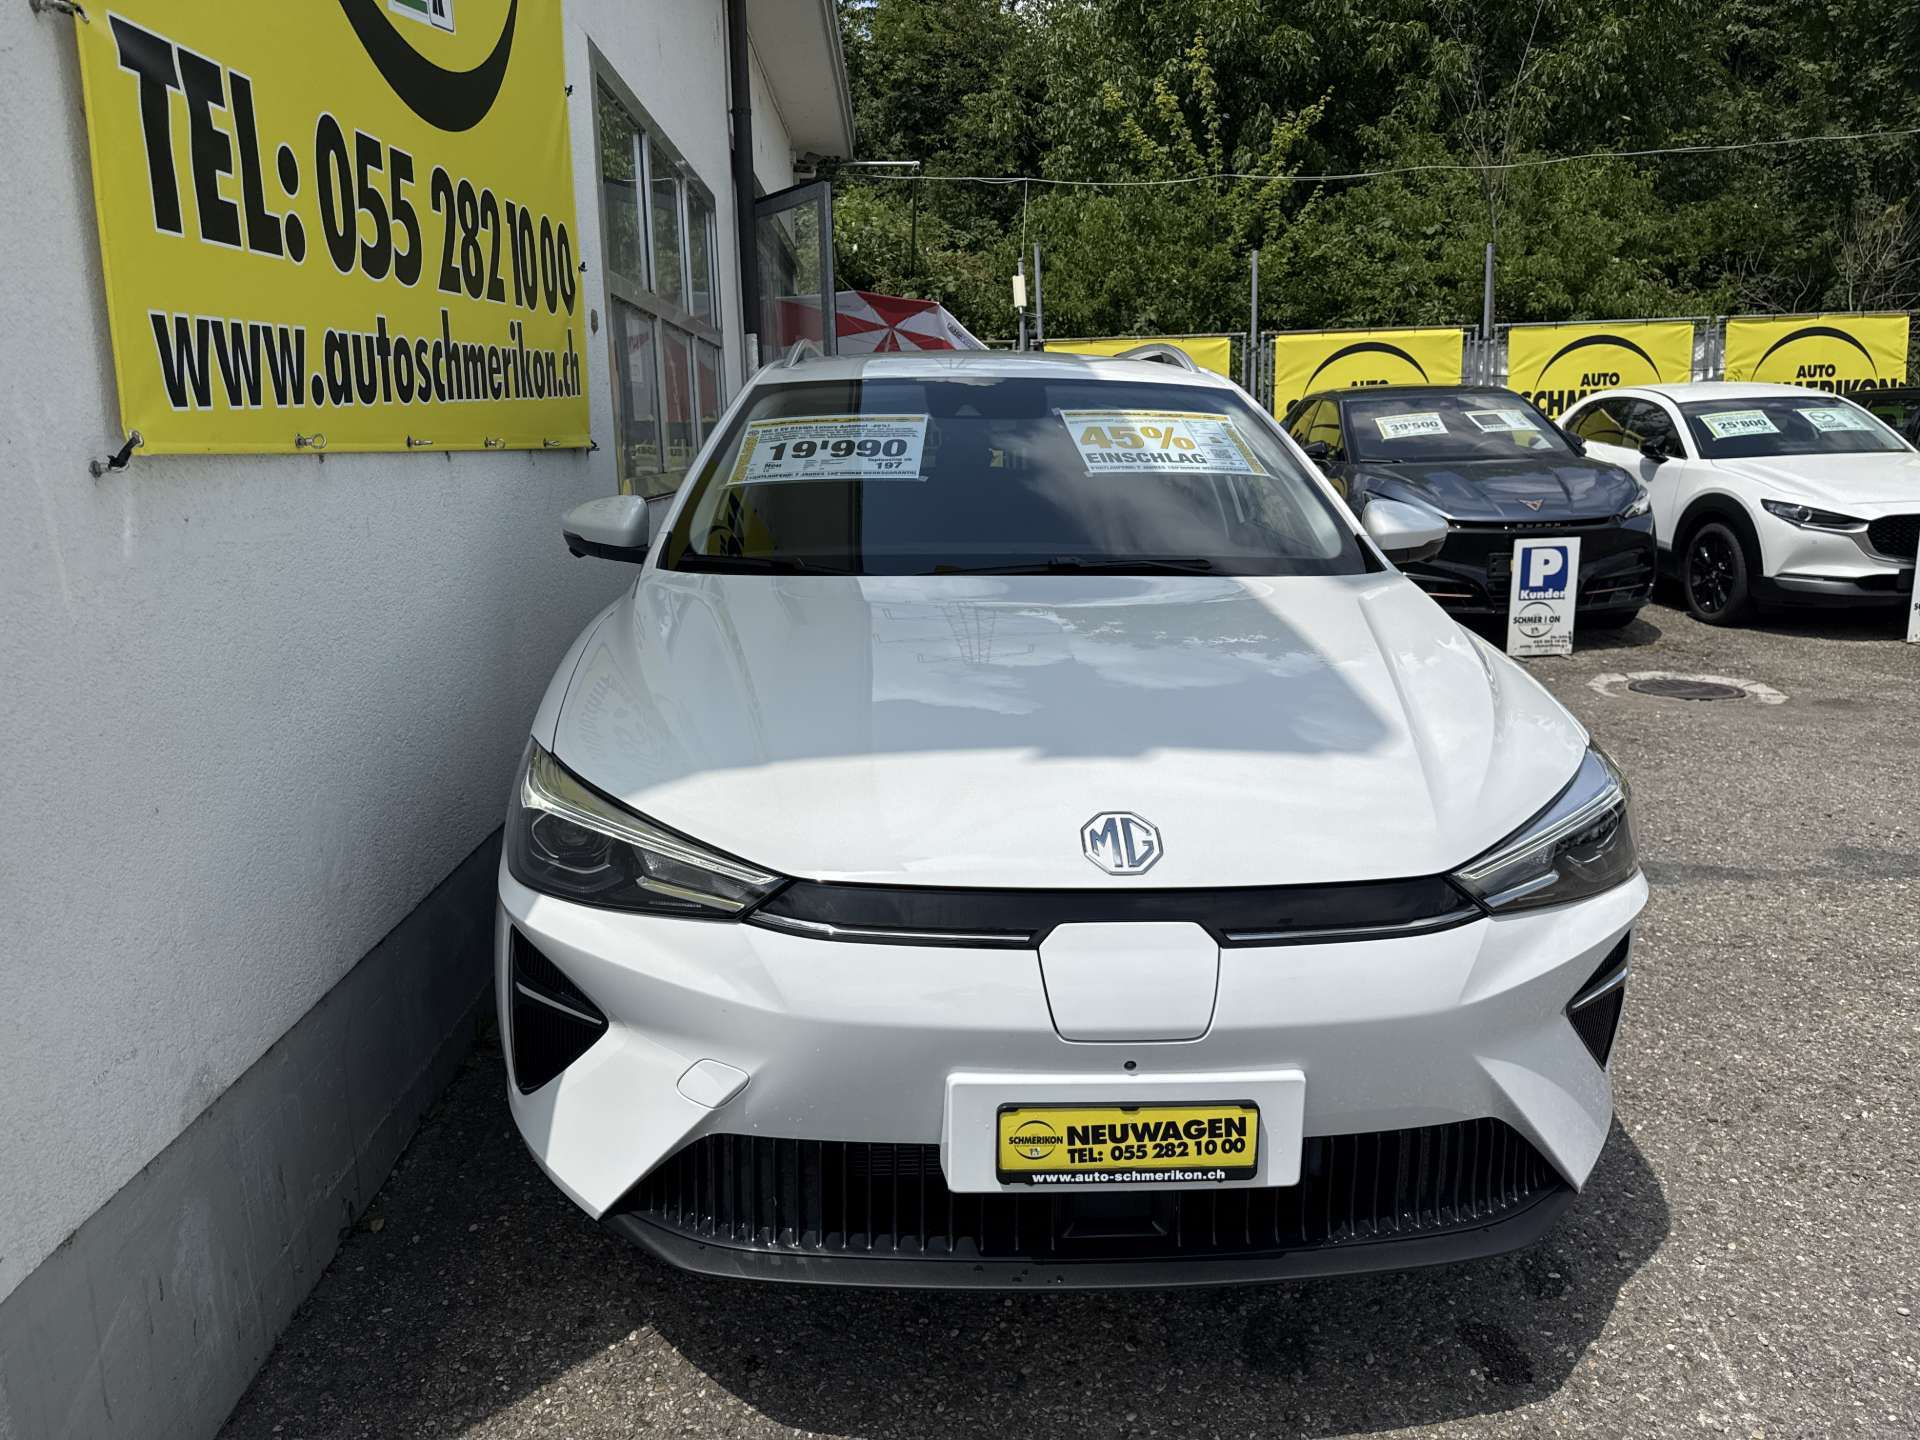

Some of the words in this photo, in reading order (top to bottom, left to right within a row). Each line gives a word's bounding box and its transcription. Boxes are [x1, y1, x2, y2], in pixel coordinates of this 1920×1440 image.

[107, 11, 306, 264] TEL:
[315, 112, 422, 287] 055
[430, 166, 506, 303] 282
[149, 308, 582, 411] www.autoschmerikon.ch
[1796, 364, 1836, 378] AUTO
[1580, 372, 1620, 387] AUTO
[769, 439, 908, 461] 19'990
[1080, 426, 1195, 450] 45%
[1086, 453, 1208, 465] EINSCHLAG
[1529, 549, 1563, 587] P
[1089, 817, 1154, 868] MG
[1008, 1136, 1063, 1145] SCHMERIKON
[1067, 1117, 1247, 1146] NEUWAGEN
[1067, 1147, 1104, 1163] TEL:
[1110, 1145, 1148, 1160] 055
[1152, 1142, 1189, 1159] 282
[1195, 1140, 1218, 1155] 10
[1221, 1138, 1246, 1153] 00
[1032, 1169, 1226, 1182] www.auto-schmerikon.ch
